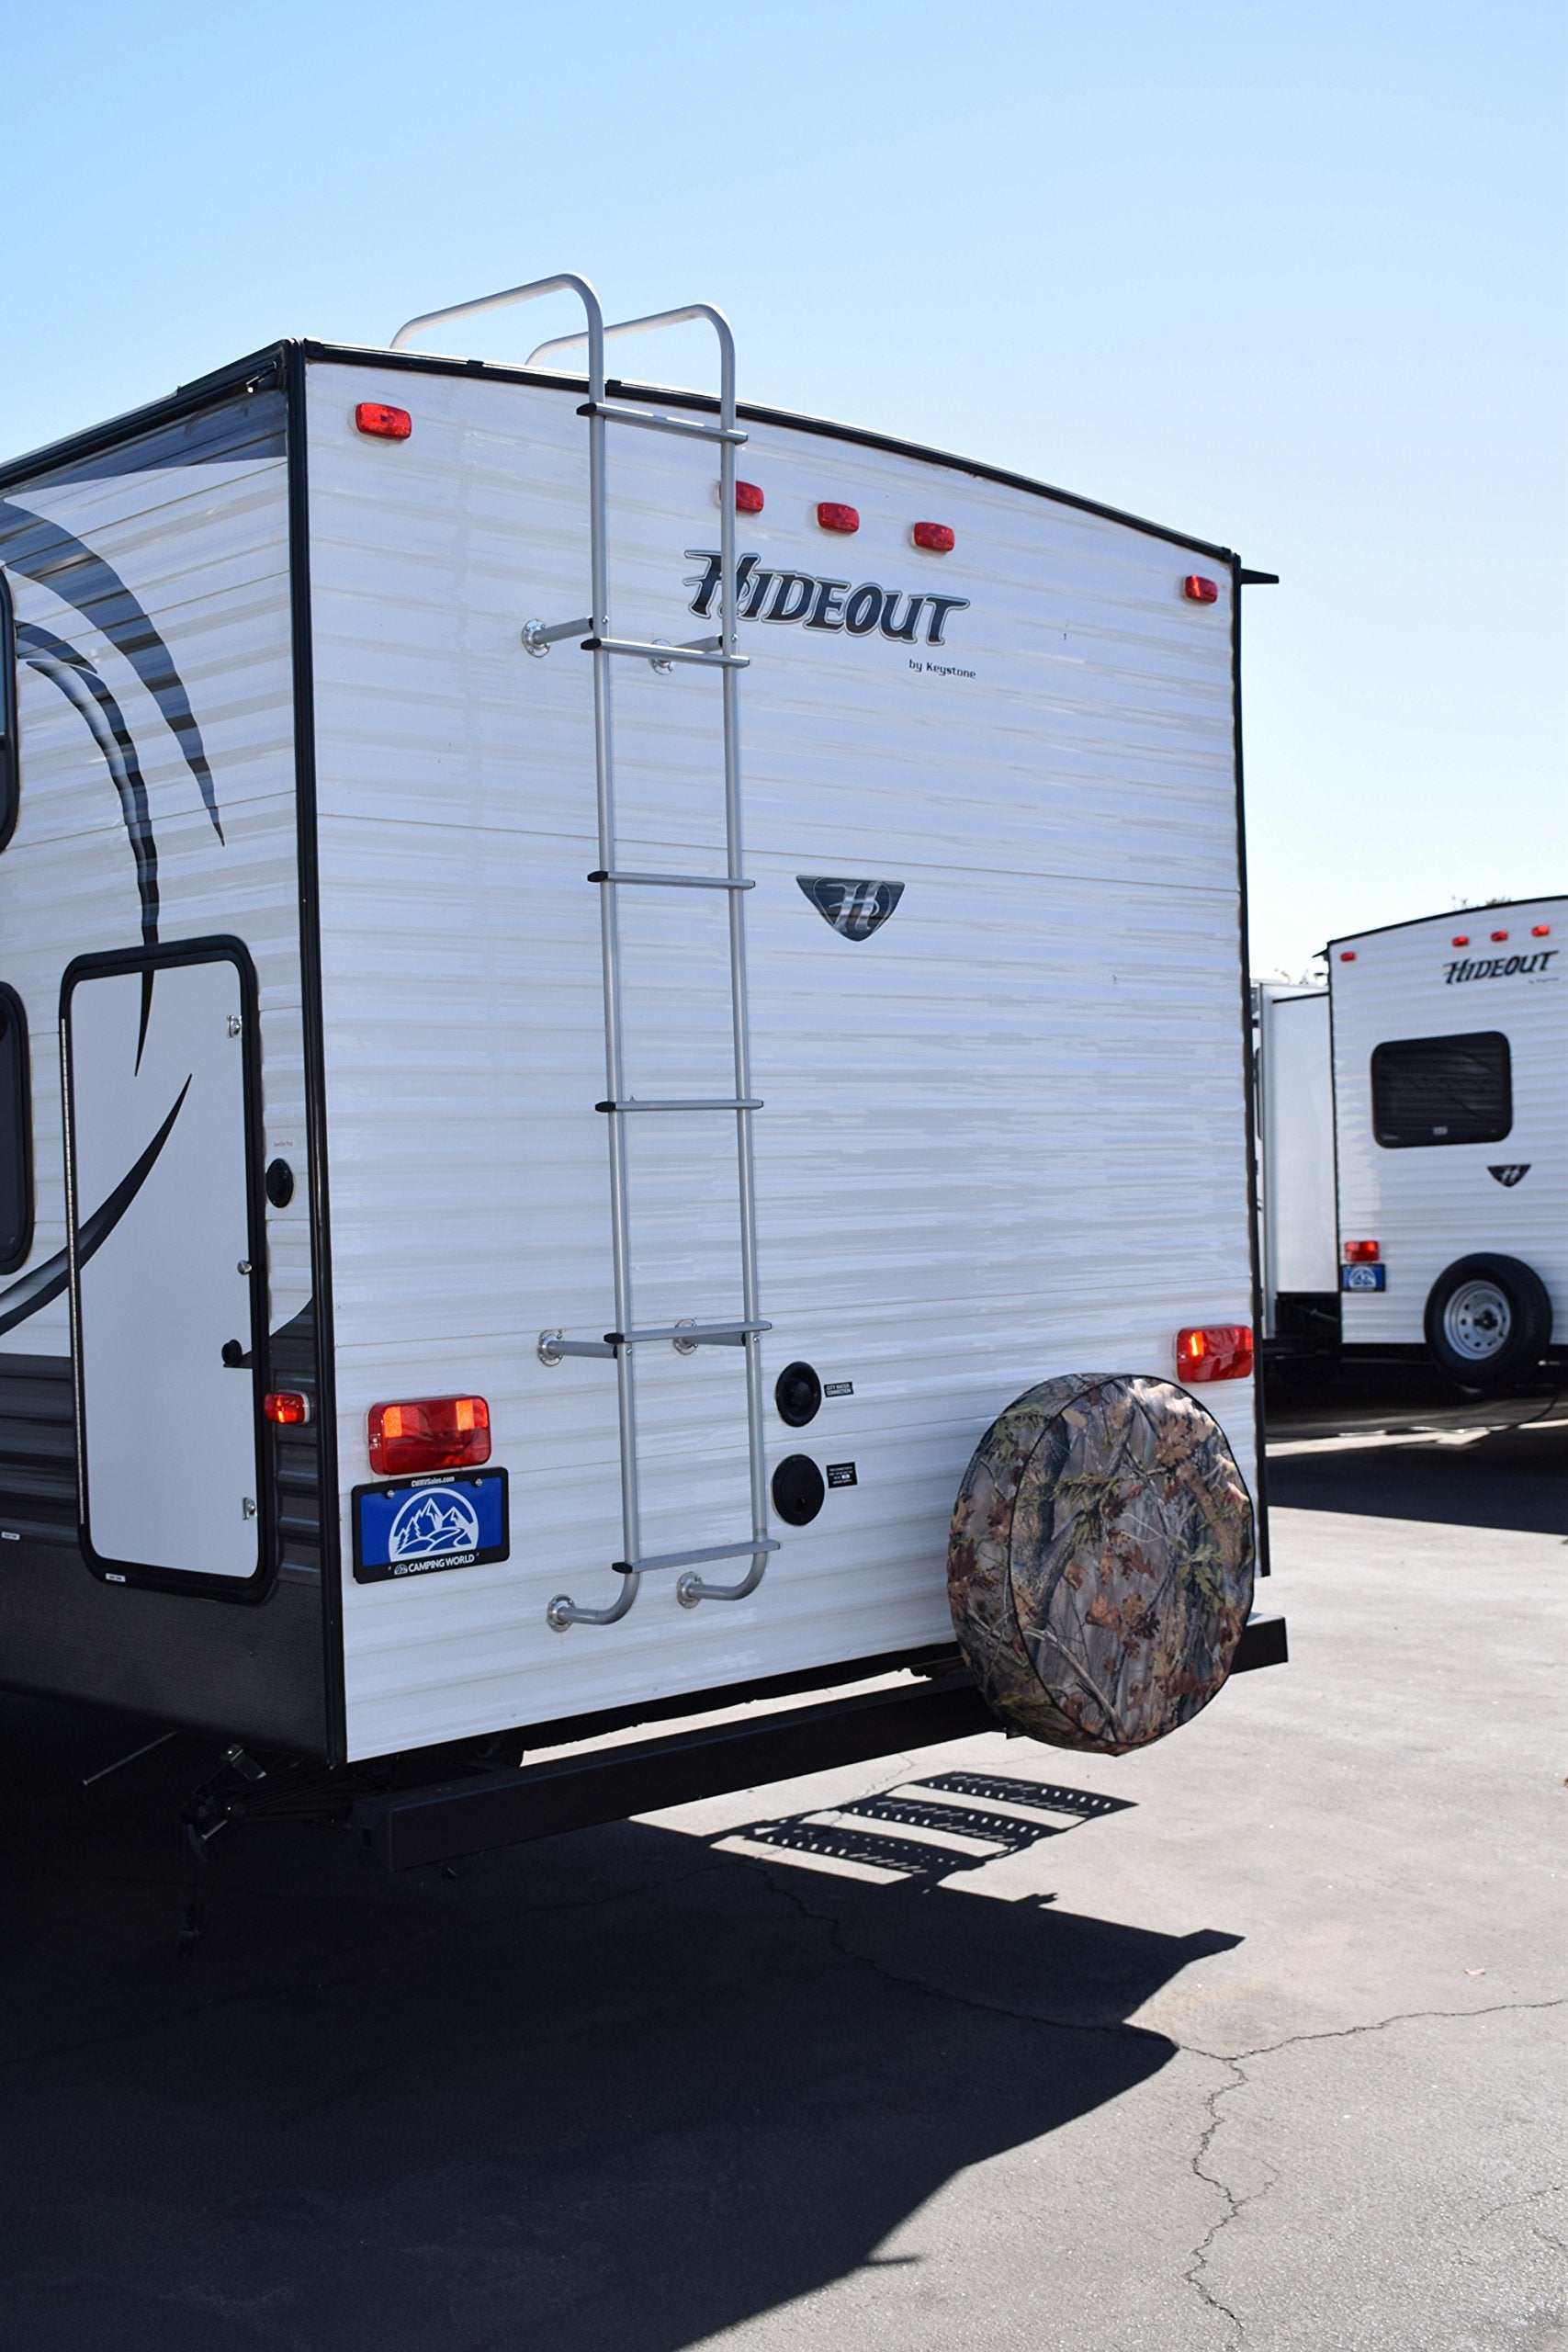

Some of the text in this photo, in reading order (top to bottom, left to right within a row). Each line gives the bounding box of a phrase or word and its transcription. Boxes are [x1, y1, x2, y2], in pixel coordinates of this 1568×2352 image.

[684, 549, 970, 646] HIDEOUT
[909, 659, 976, 679] by Keystone
[1443, 950, 1559, 984] HIDEOUT
[408, 1554, 475, 1573] CAMPING WORLD
